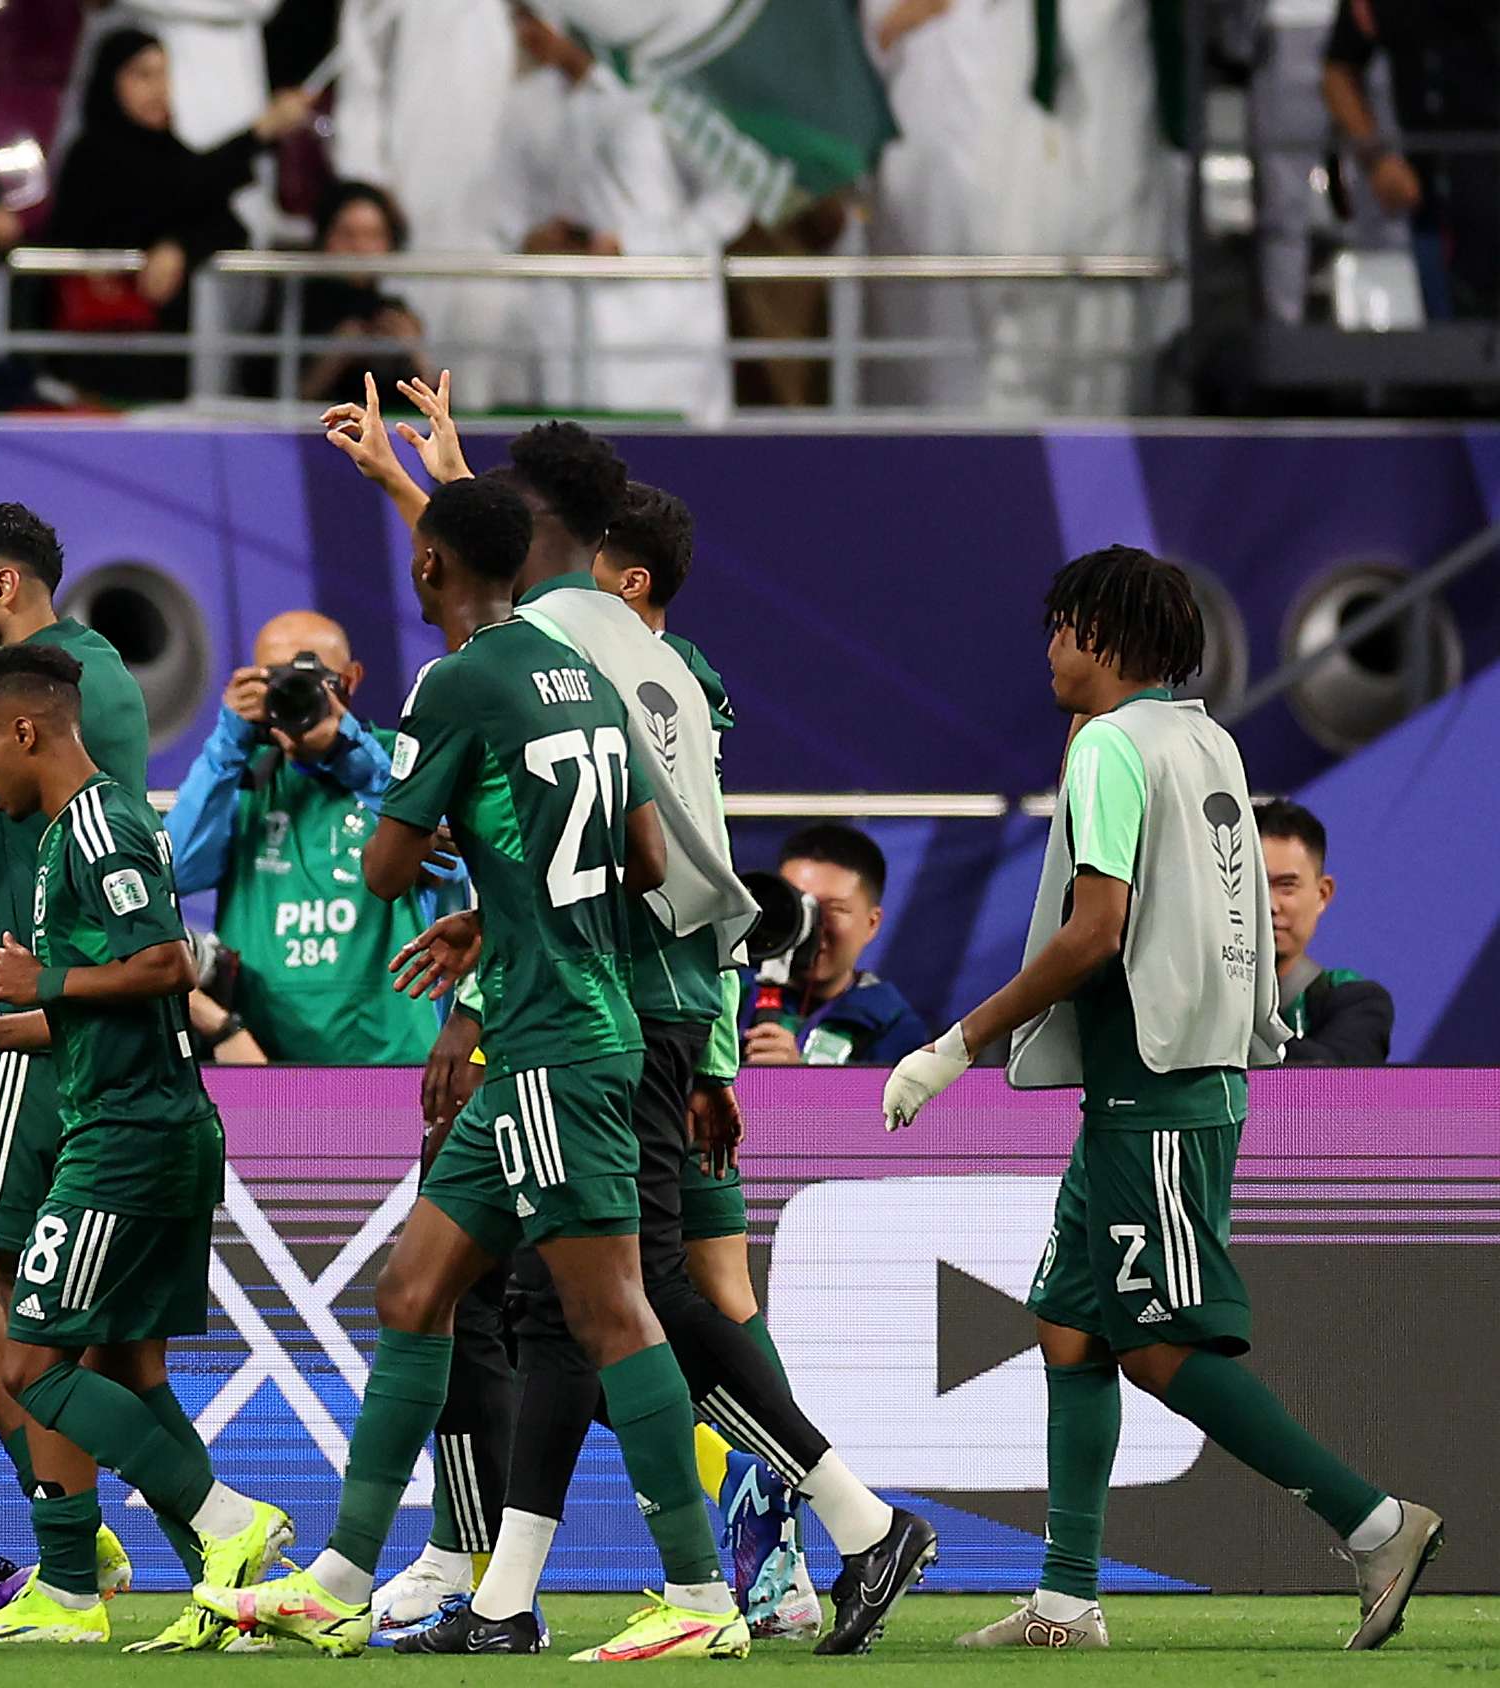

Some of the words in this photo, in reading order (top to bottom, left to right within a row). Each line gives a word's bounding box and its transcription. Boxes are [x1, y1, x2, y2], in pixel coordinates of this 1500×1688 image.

[524, 727, 629, 909] 20
[275, 898, 357, 937] PHO
[284, 936, 339, 969] 284
[16, 1214, 69, 1286] 8
[1108, 1224, 1153, 1293] 2
